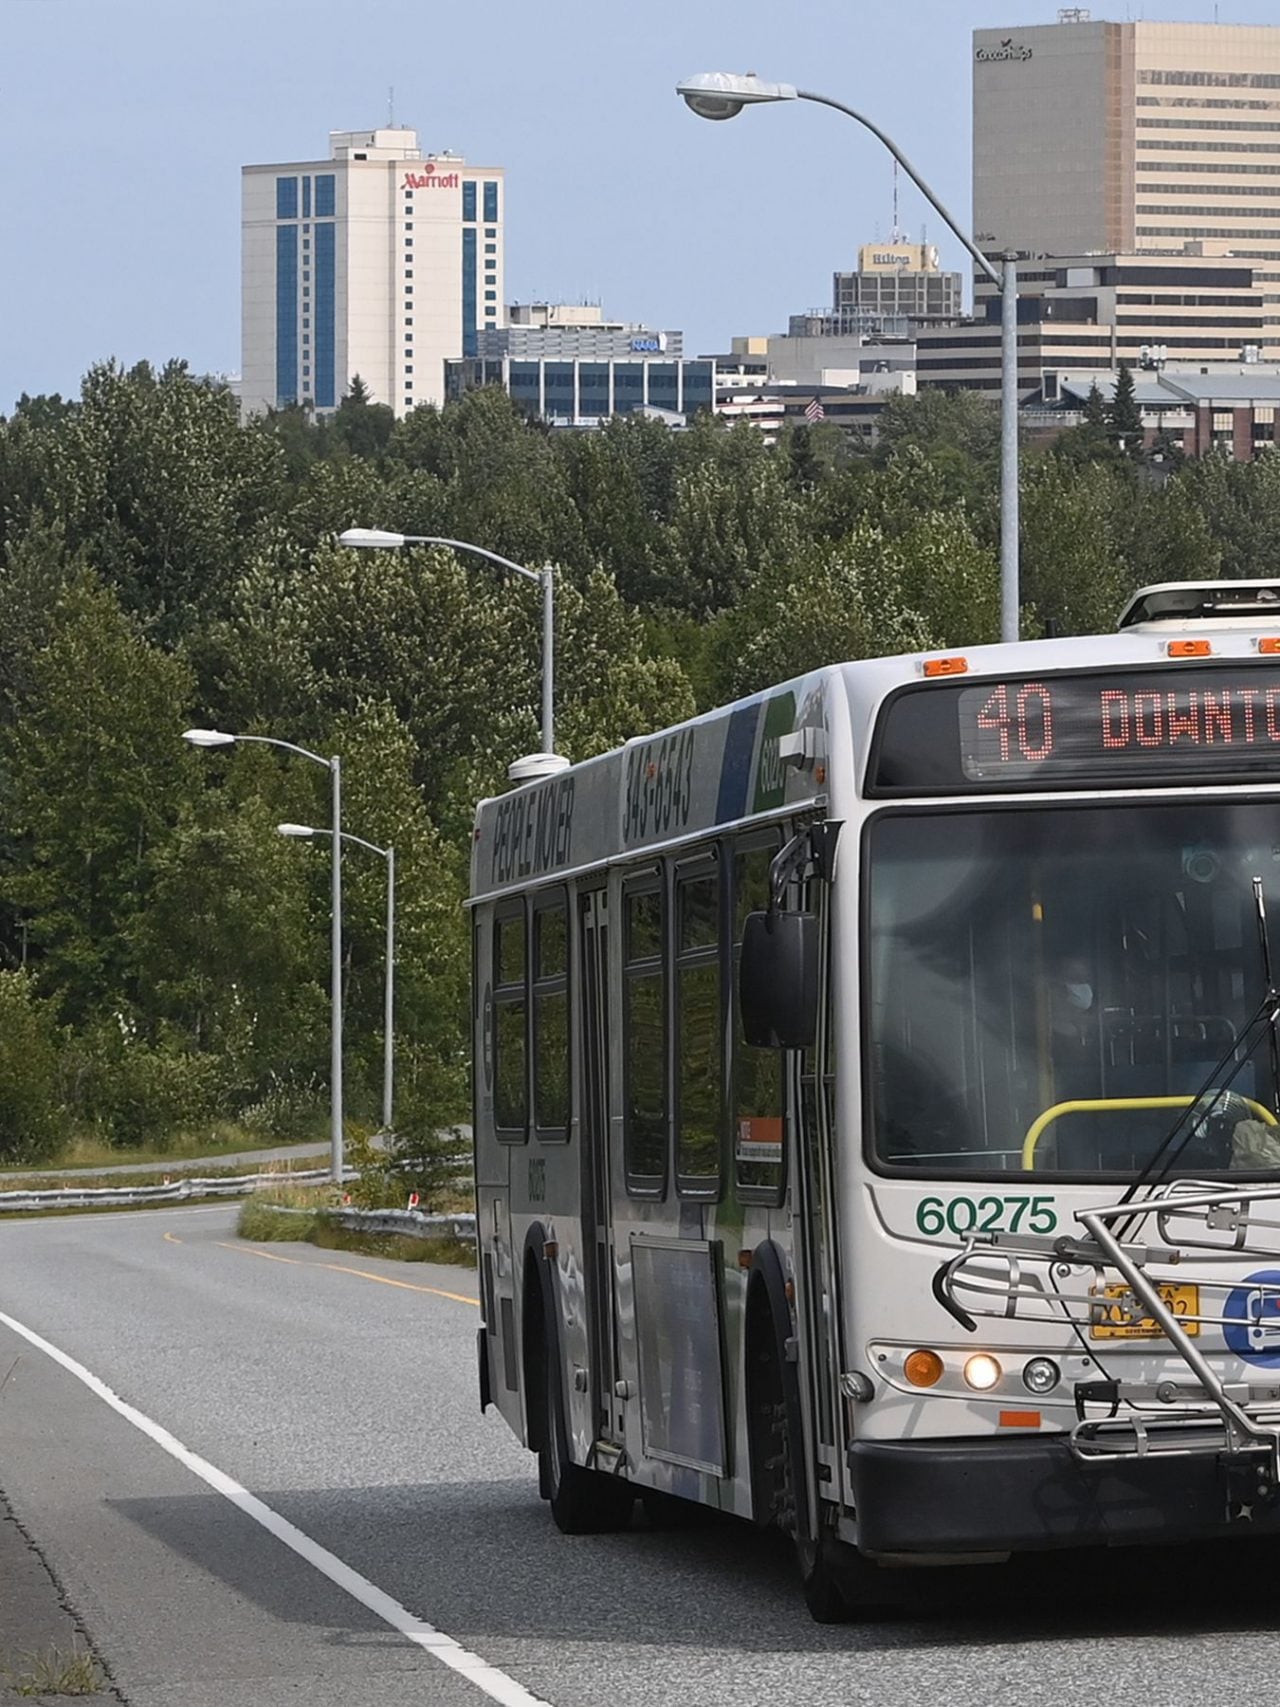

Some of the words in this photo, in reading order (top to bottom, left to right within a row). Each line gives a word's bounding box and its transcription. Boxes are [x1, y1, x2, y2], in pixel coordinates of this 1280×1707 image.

[400, 164, 458, 189] Marriott
[873, 253, 910, 265] Hilton
[977, 684, 1052, 760] 40
[622, 728, 695, 843] 343-6543
[491, 791, 537, 884] PEOPLE
[532, 777, 575, 874] MOVER
[916, 1196, 1057, 1235] 60275
